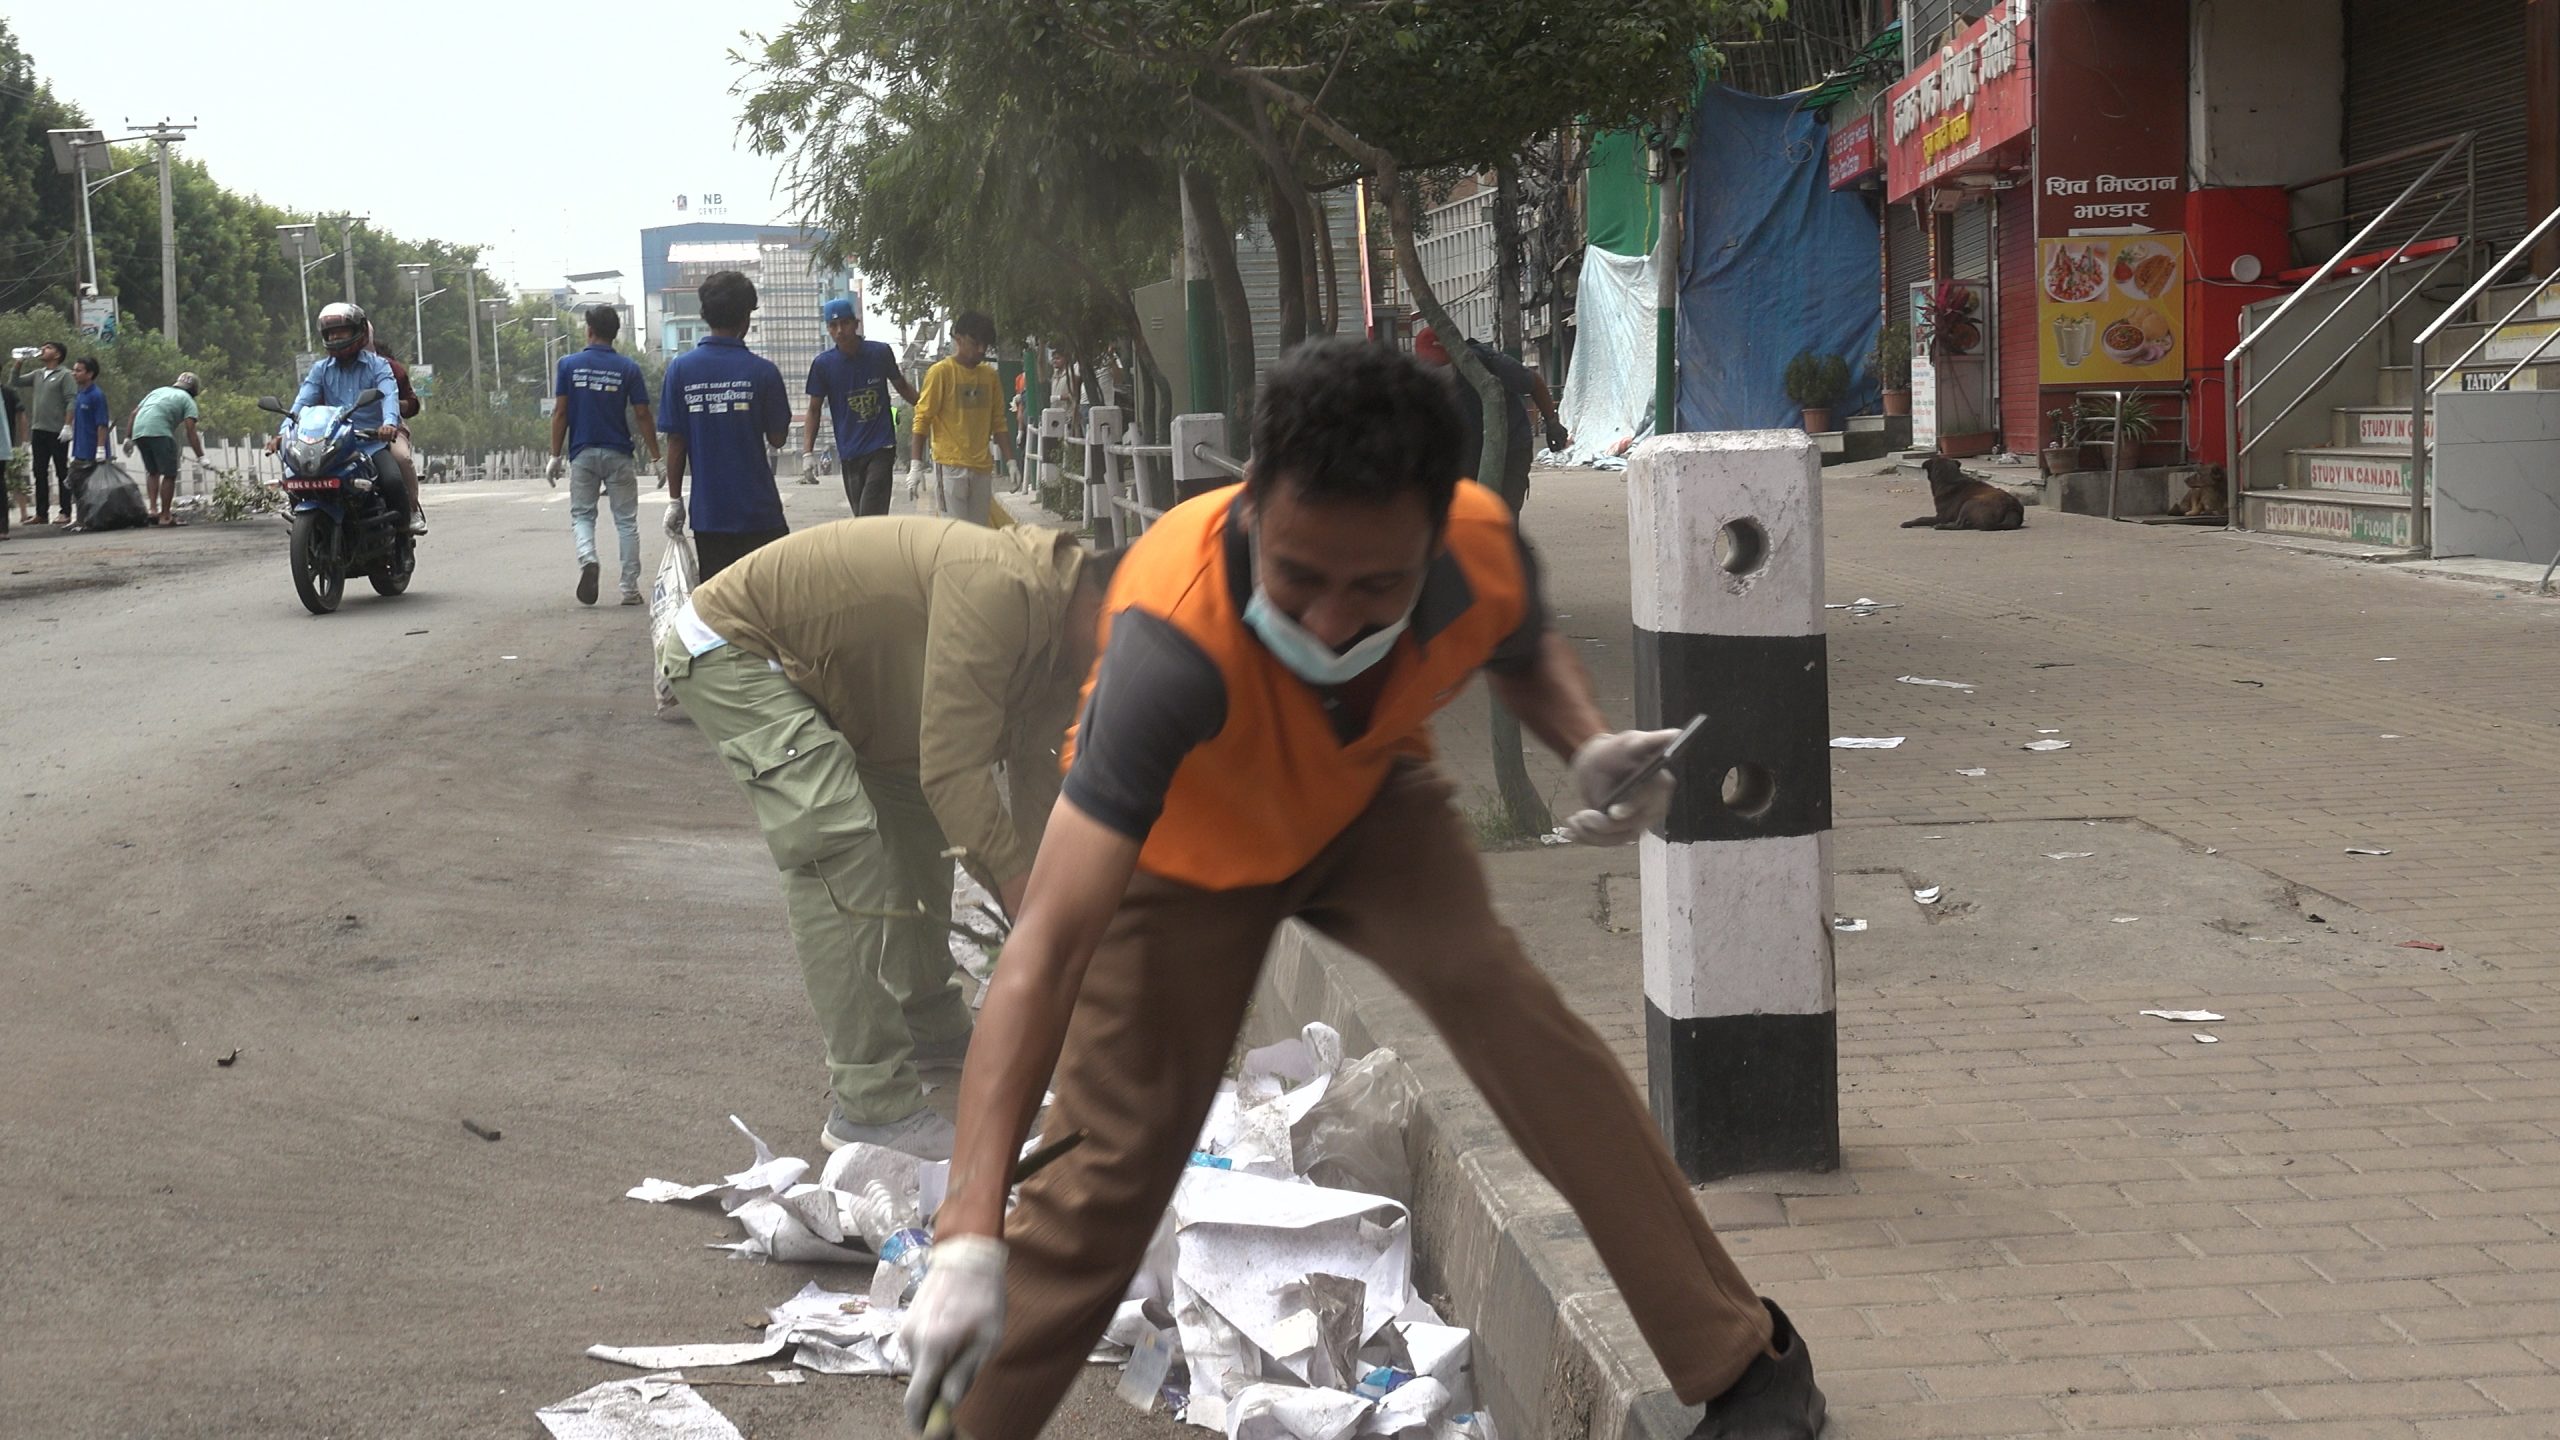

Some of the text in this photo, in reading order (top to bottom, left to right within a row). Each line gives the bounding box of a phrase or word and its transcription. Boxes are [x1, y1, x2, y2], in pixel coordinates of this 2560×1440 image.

[2045, 174, 2178, 196] शिव मिष्ठान
[704, 193, 722, 204] NB
[698, 207, 728, 215] CENTER
[2074, 202, 2150, 219] भण्डार
[684, 382, 708, 392] CLIMATE
[710, 381, 731, 389] SMART
[2361, 419, 2392, 437] STUDY
[2395, 420, 2404, 437] IN
[2311, 465, 2341, 484] STUDY
[2344, 467, 2354, 482] IN
[2356, 467, 2401, 488] CANADA
[2267, 506, 2296, 526] STUDY
[2297, 508, 2307, 527] IN
[2309, 508, 2350, 532] CANADA
[2363, 519, 2392, 538] FLOOR
